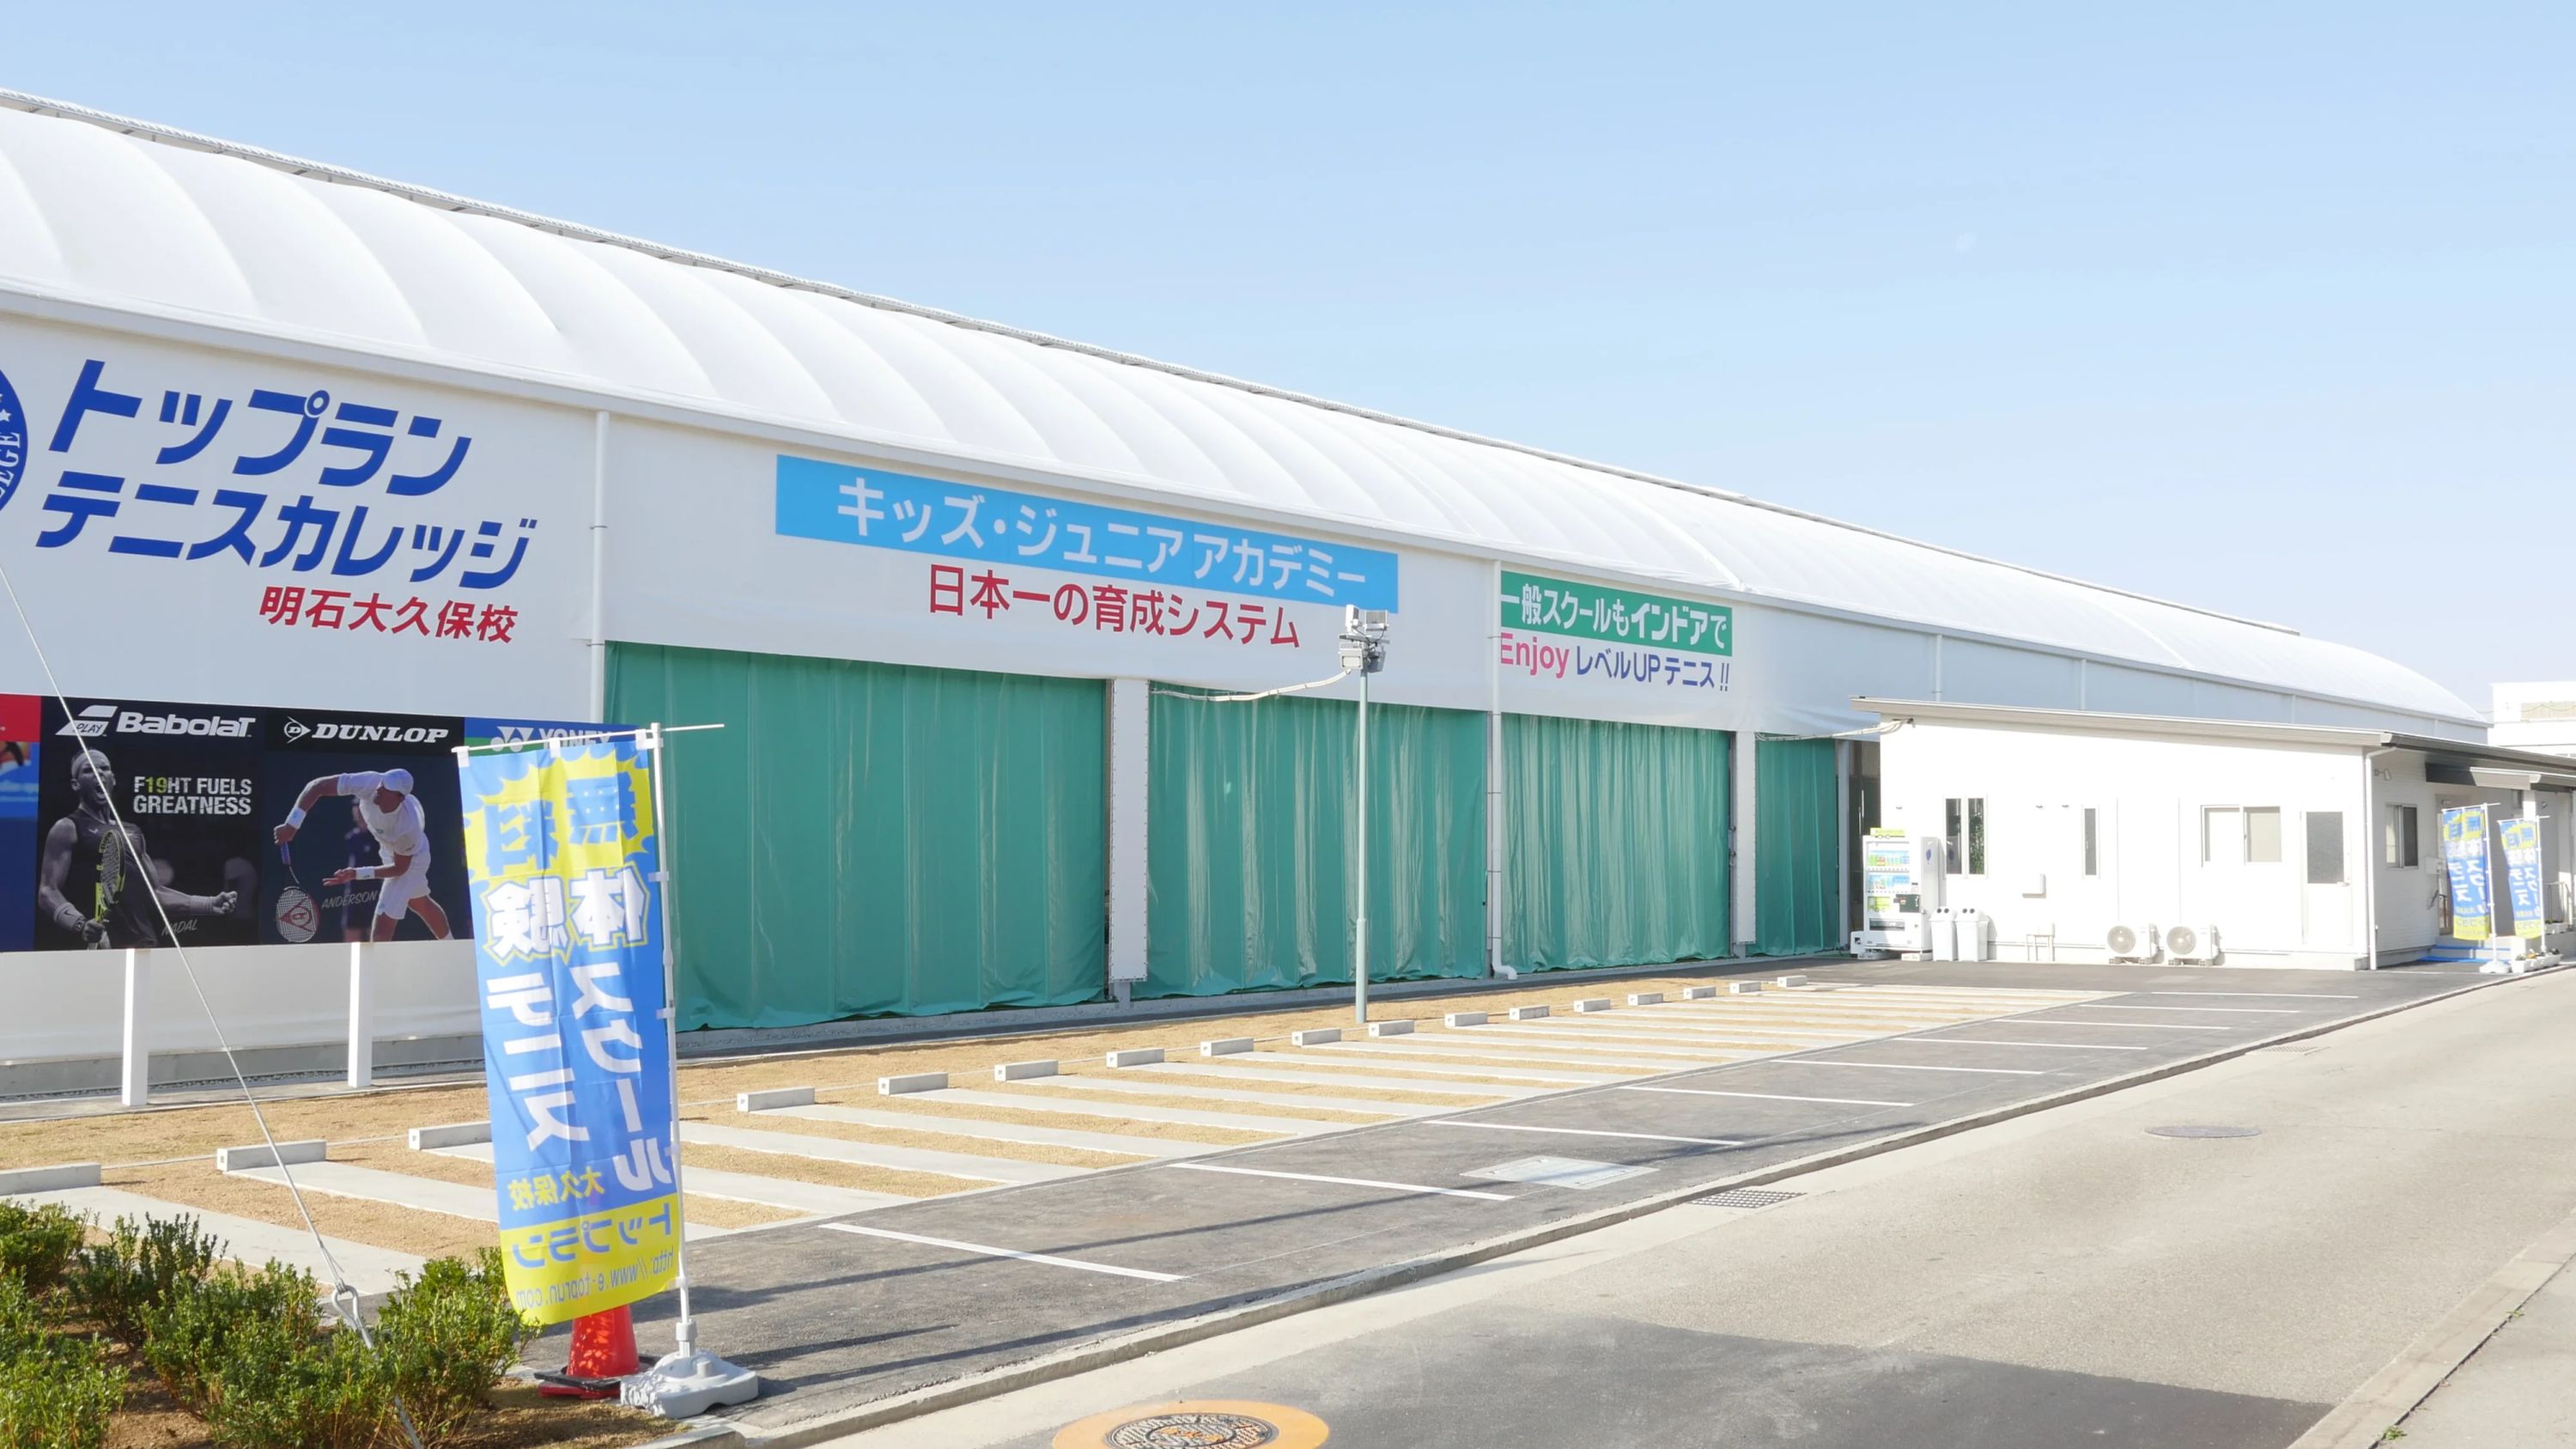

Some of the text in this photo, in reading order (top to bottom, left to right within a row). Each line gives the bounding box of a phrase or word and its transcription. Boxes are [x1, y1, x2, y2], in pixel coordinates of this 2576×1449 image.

[49, 359, 471, 496] トップラン
[36, 470, 538, 589] テニスカレッジ
[259, 586, 519, 642] 明石大久保校
[929, 563, 1300, 648] 日本一の育成システム
[1501, 583, 1727, 649] 一般スクールもインドアで
[1500, 631, 1570, 679] Enjoy
[312, 723, 449, 743] DUNLOP
[133, 795, 252, 815] GREATNESS
[134, 776, 252, 796] F19HT FUELS
[320, 890, 379, 910] ANDERSON
